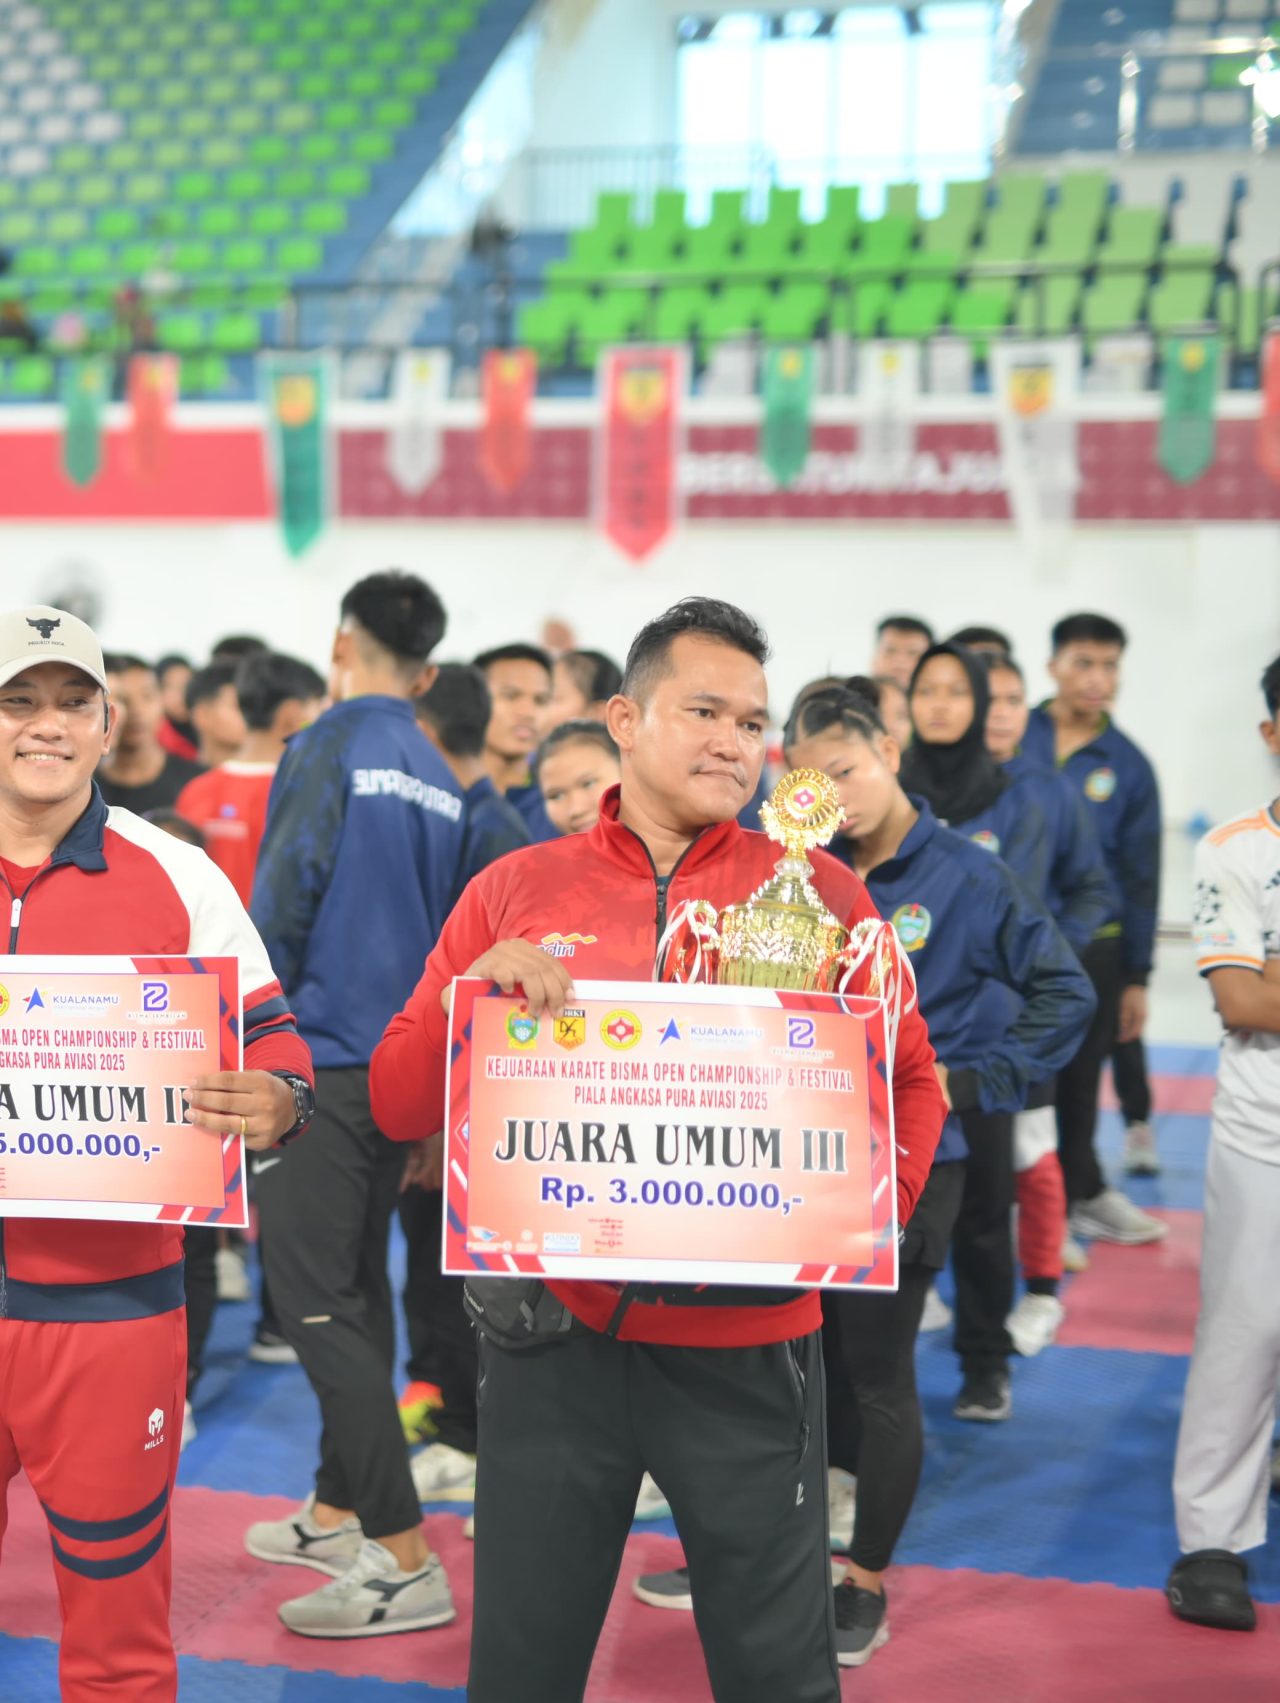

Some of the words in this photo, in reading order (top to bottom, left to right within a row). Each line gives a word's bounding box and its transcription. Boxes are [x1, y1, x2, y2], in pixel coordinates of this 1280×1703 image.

[53, 995, 119, 1005] KUALANAMU
[22, 1029, 49, 1047] OPEN
[54, 1030, 137, 1048] CHAMPIONSHIP
[142, 1031, 149, 1048] &
[154, 1031, 205, 1049] FESTIVAL
[34, 1052, 61, 1069] PURA
[64, 1053, 96, 1070] AVIASI
[100, 1054, 125, 1071] 2025
[488, 1058, 556, 1078] KEJUARAAN
[561, 1060, 605, 1079] KARATE
[611, 1061, 648, 1081] BISMA
[654, 1062, 685, 1082] OPEN
[690, 1063, 782, 1086] CHAMPIONSHIP
[787, 1068, 795, 1087] &
[800, 1069, 853, 1090] FESTIVAL
[33, 1084, 148, 1122] UMUM
[574, 1086, 606, 1104] PIALA
[610, 1087, 662, 1106] ANGKASA
[666, 1088, 696, 1107] PURA
[700, 1090, 736, 1108] AVIASI
[740, 1091, 768, 1110] 2025
[495, 1119, 637, 1164] JUARA
[654, 1124, 782, 1169] UMUM
[801, 1128, 848, 1172] III
[541, 1176, 595, 1208] Rp.
[609, 1178, 802, 1215] 3.000.000,-
[144, 1434, 164, 1450] MILLS
